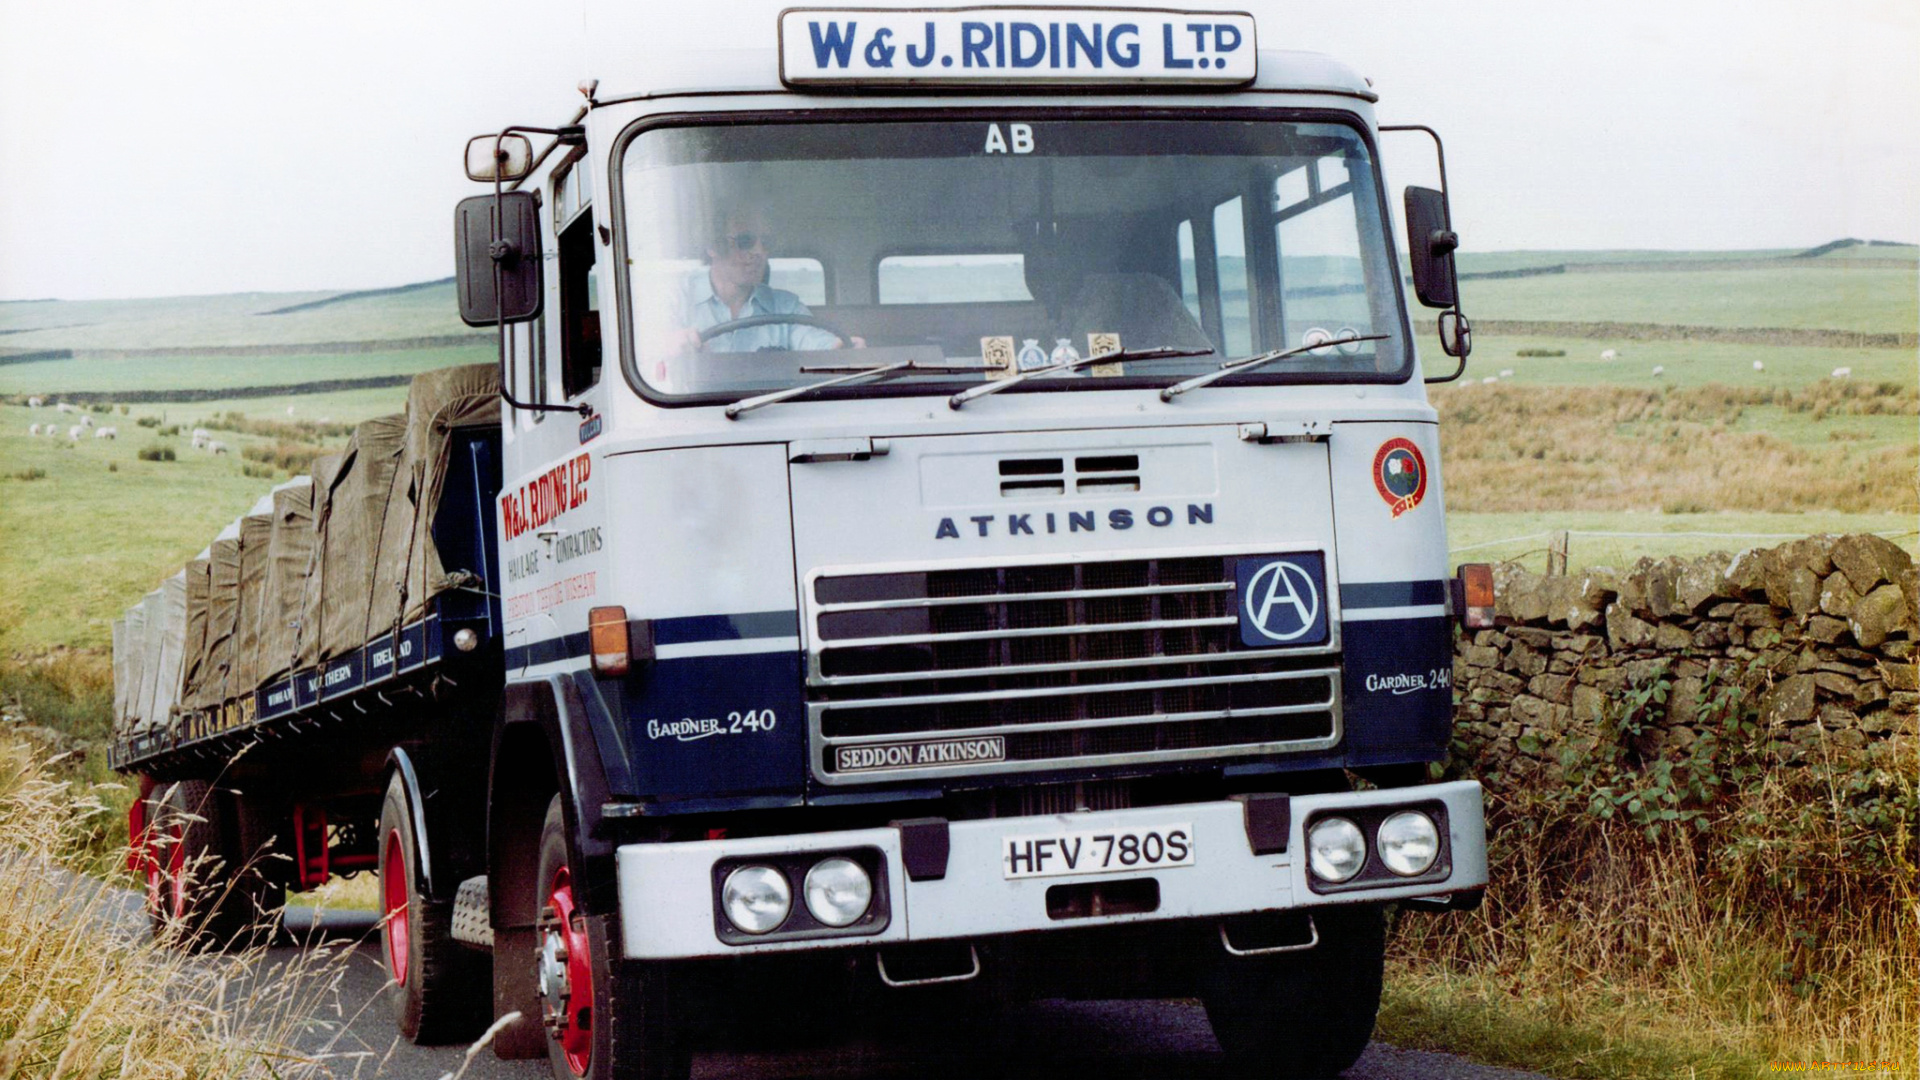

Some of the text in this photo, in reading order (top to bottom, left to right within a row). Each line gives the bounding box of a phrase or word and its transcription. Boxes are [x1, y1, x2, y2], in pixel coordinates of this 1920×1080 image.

[961, 22, 1140, 69] RIDING
[984, 123, 1035, 154] AB
[529, 463, 567, 530] RIDING
[935, 503, 1214, 539] ATKINSON
[556, 526, 602, 563] CONTRACTORS
[308, 640, 412, 693] NOTHERN IRELND
[1365, 667, 1452, 695] GARDNER 240
[647, 708, 776, 741] GARDNER 240
[840, 739, 1001, 769] SEDDON ATKINSON
[1010, 830, 1188, 873] HFV 780S
